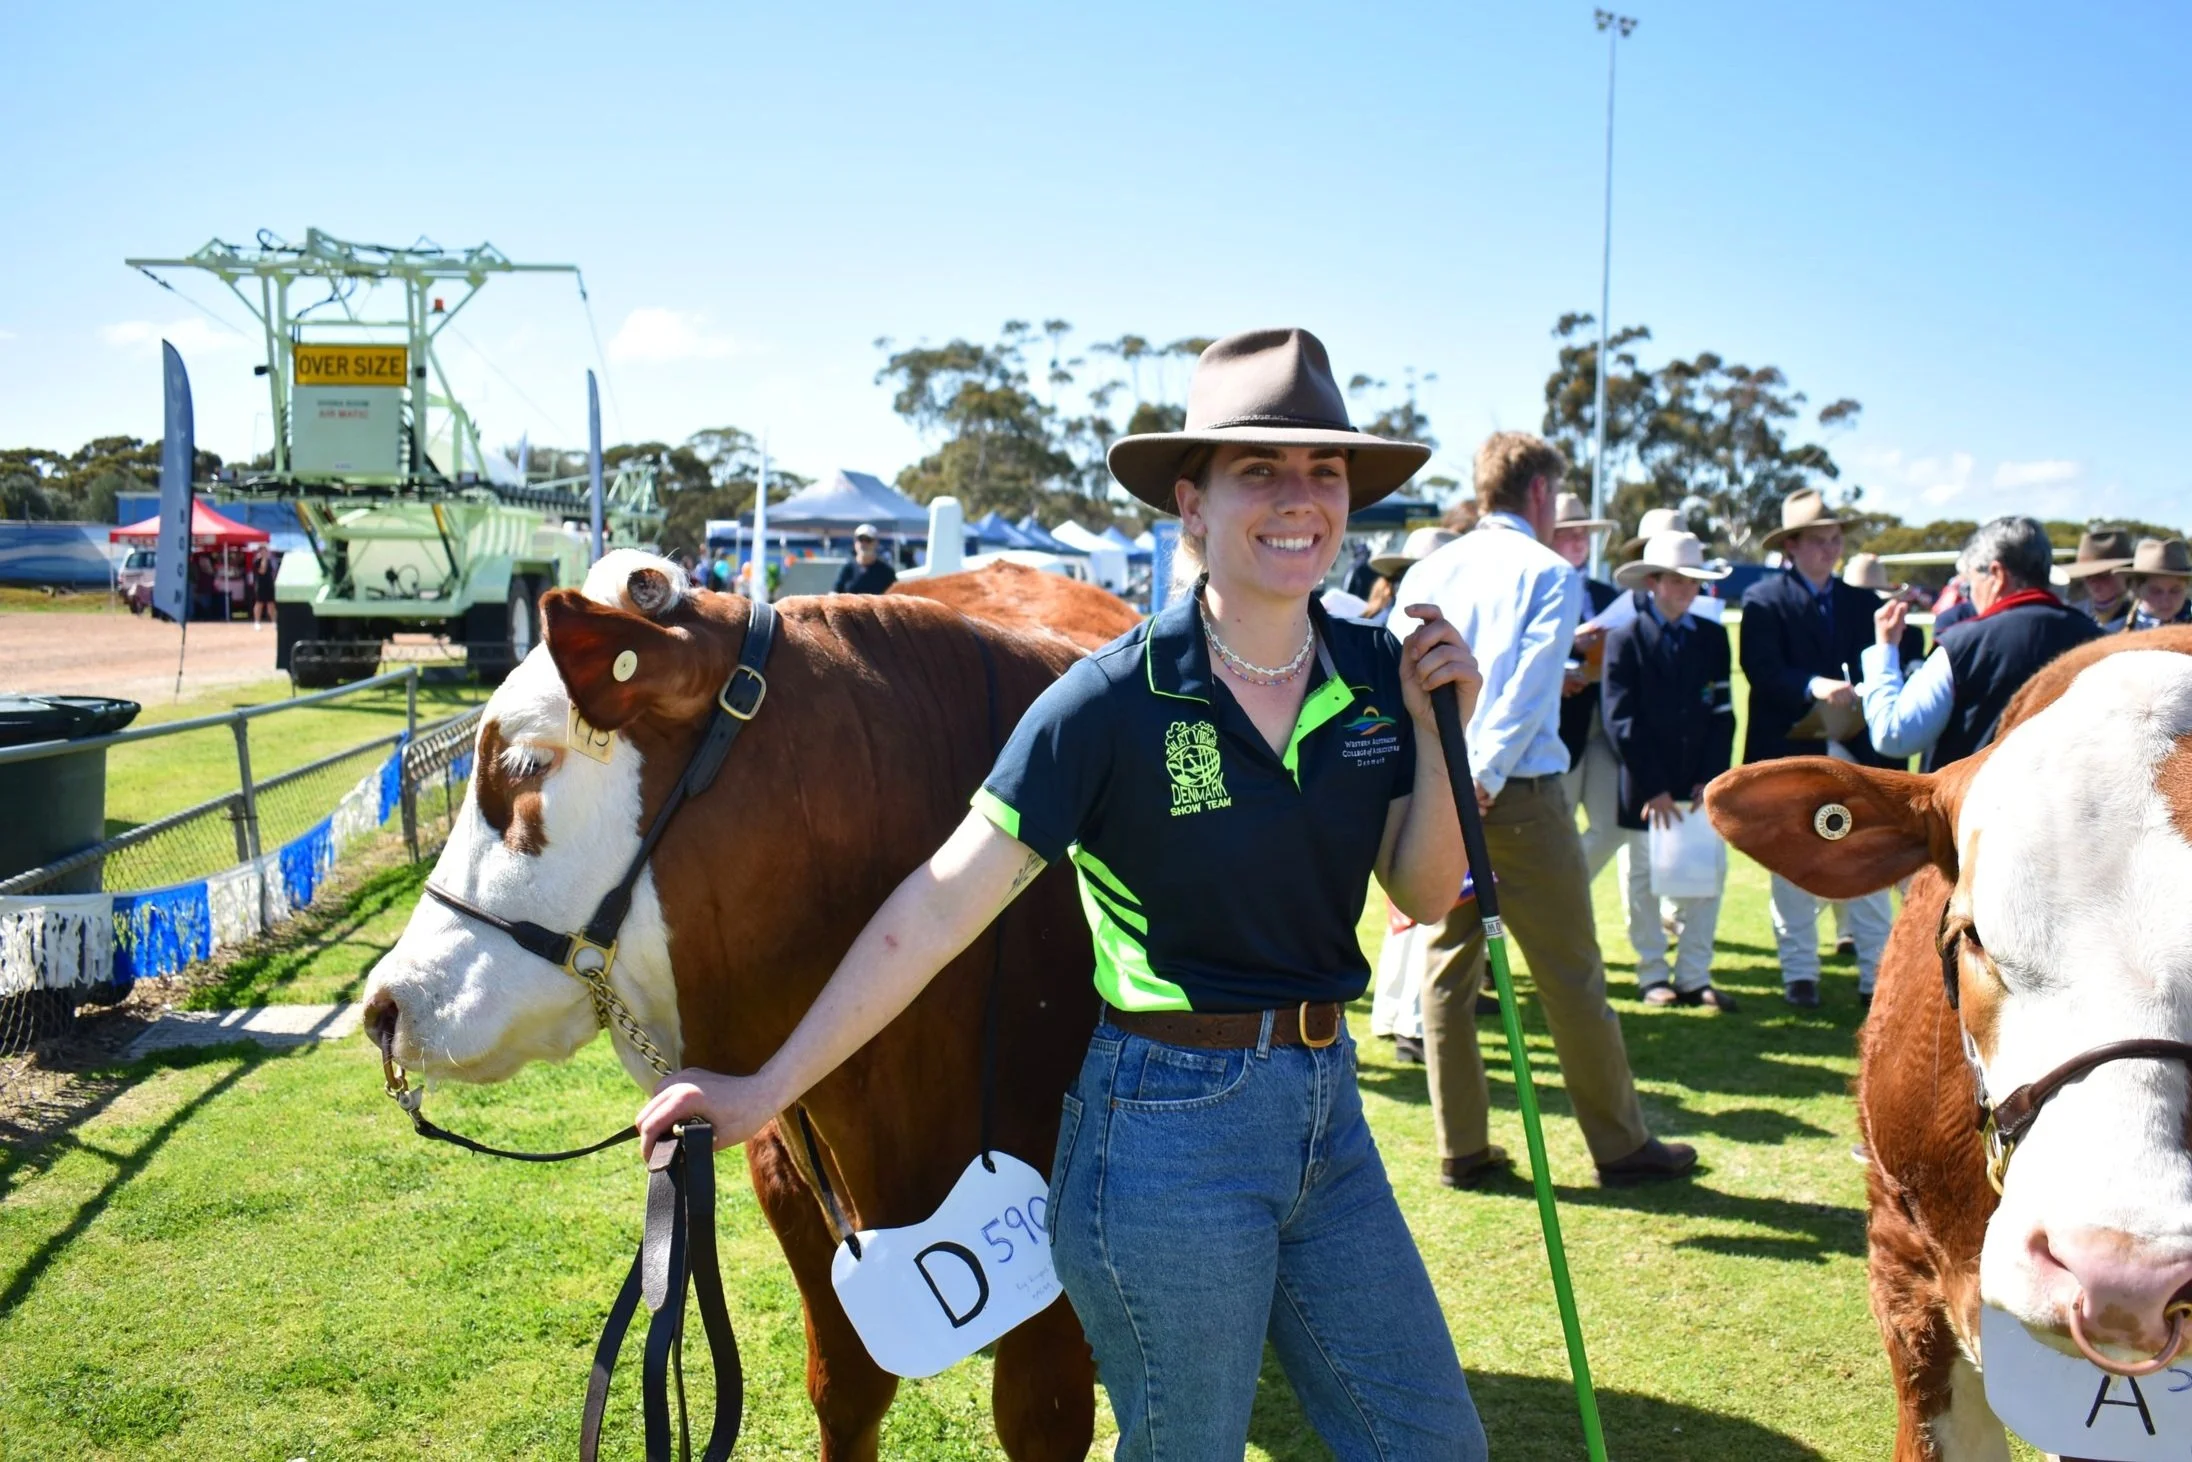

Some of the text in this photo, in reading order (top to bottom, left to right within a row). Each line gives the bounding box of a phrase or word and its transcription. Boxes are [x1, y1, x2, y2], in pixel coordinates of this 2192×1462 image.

[299, 355, 403, 377] OVER SIZE
[1171, 772, 1228, 806] DENMARK
[1170, 797, 1231, 817] SHOW TEAM
[913, 1241, 989, 1328] D
[2085, 1374, 2156, 1436] A
